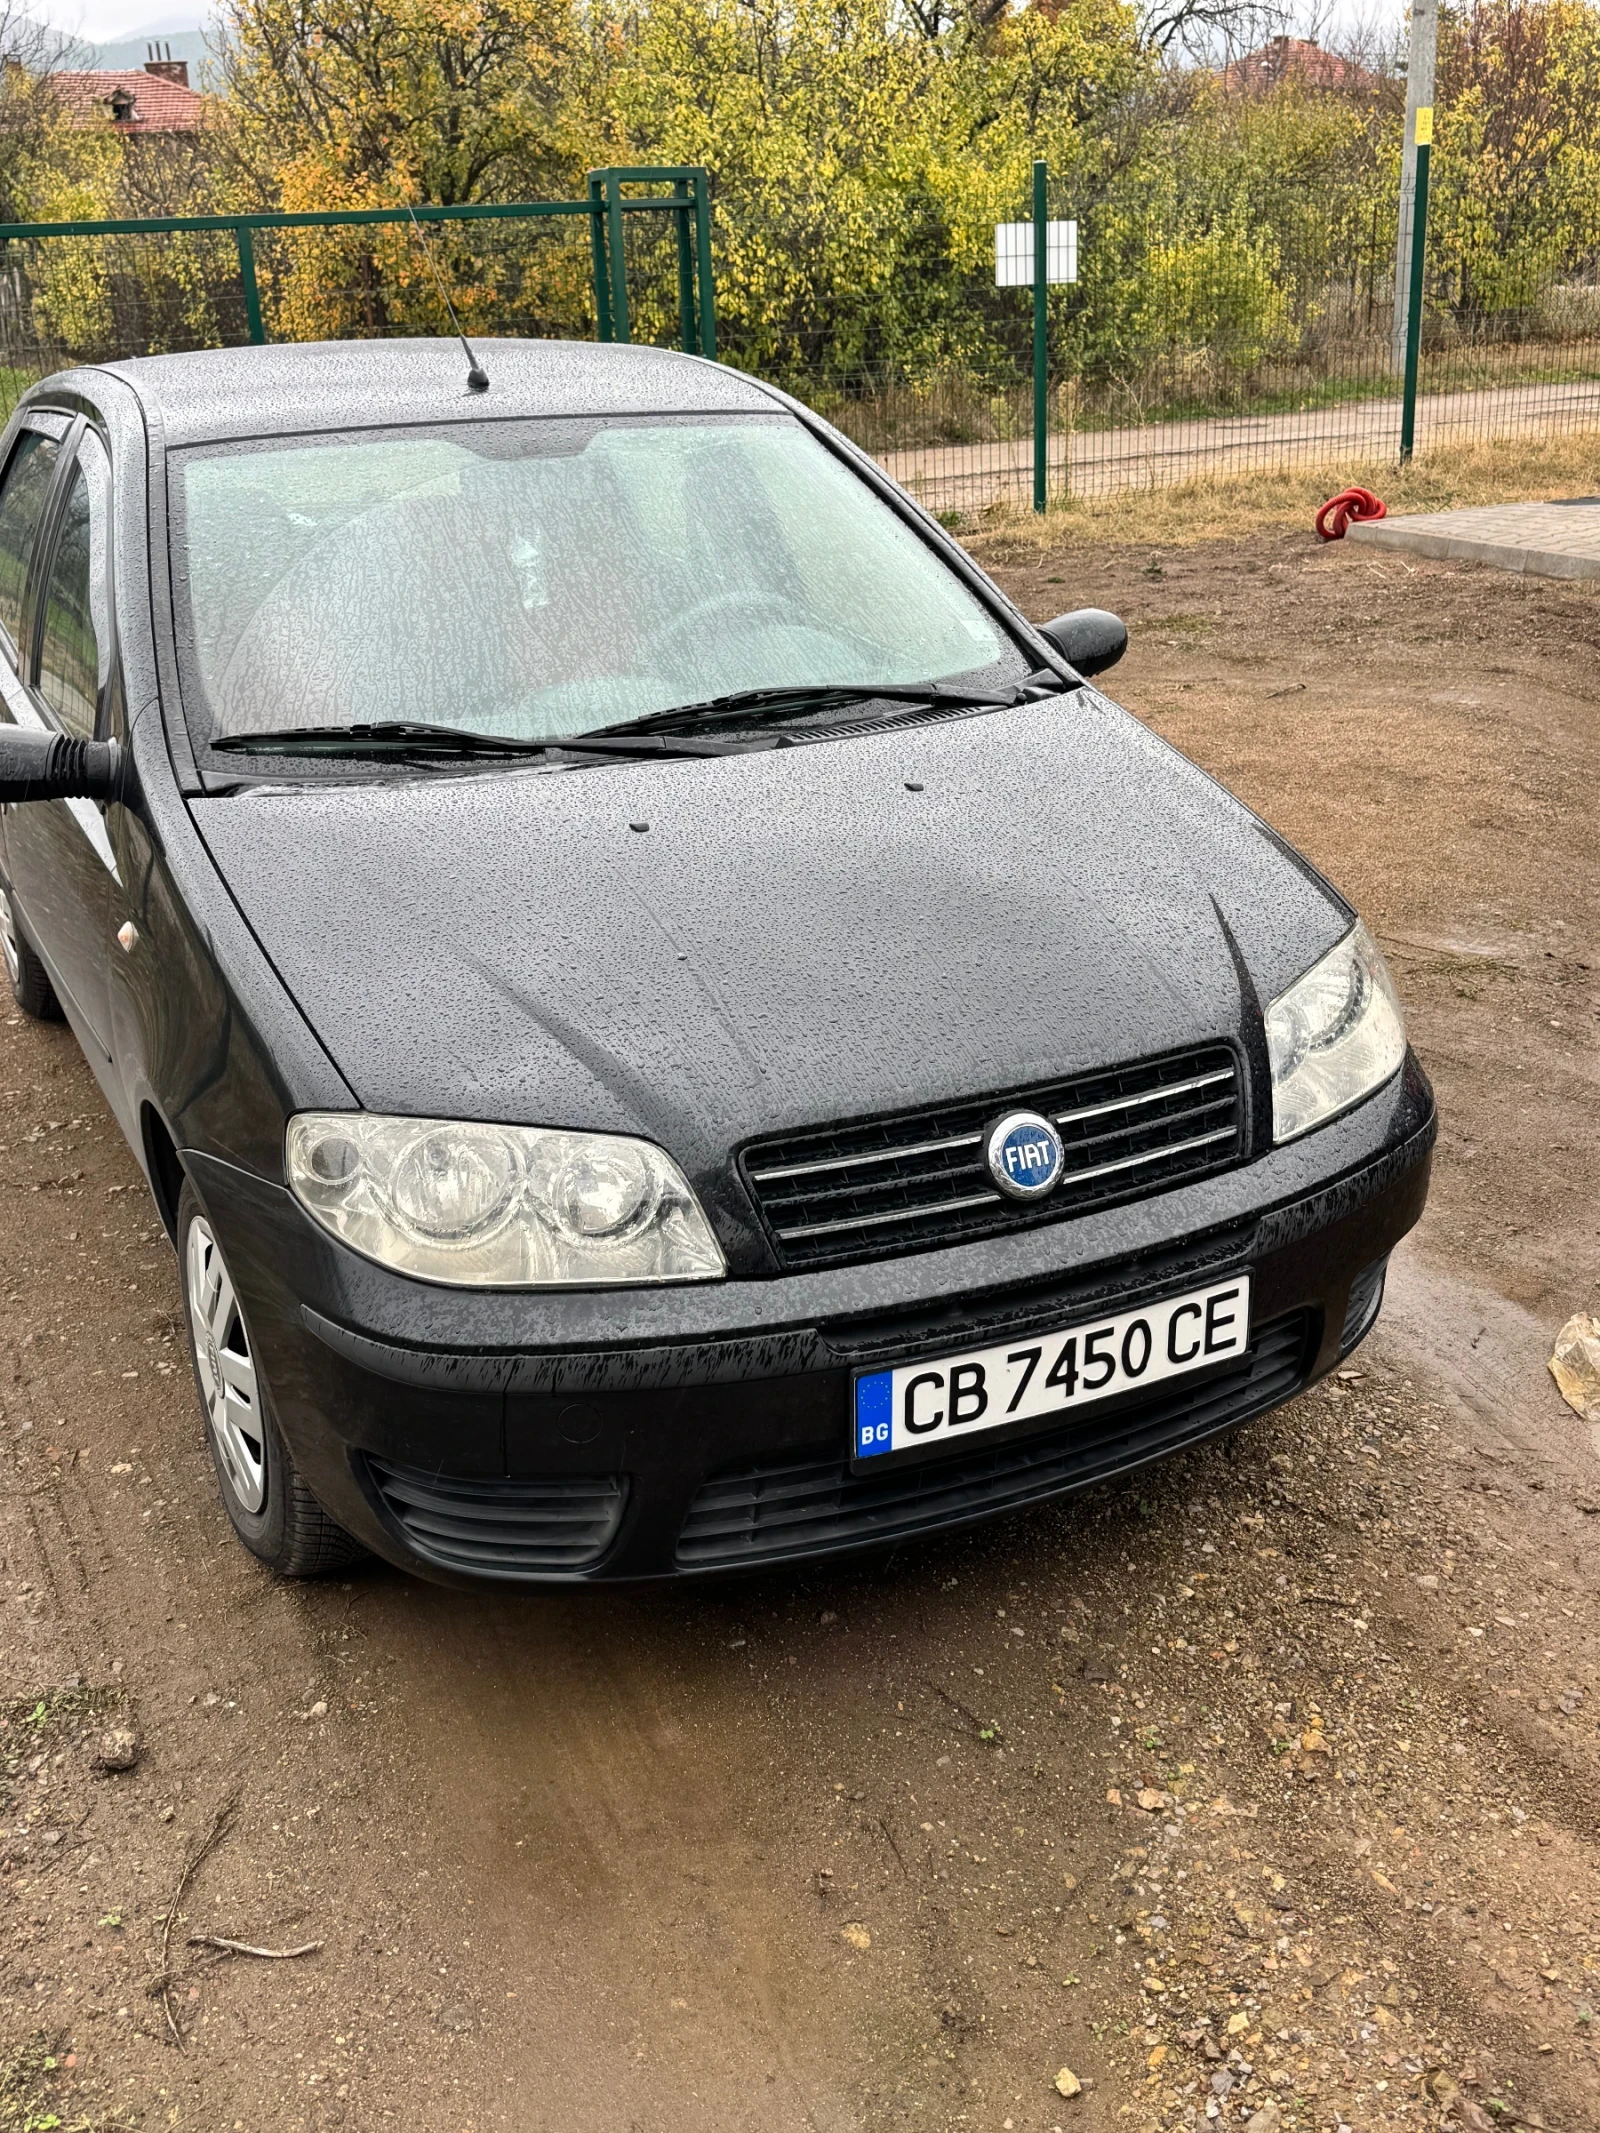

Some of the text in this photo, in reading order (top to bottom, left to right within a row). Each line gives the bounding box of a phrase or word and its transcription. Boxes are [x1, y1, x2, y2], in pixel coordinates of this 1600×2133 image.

[1005, 1140, 1050, 1173] FIAT
[904, 1288, 1240, 1434] CB 7450 CE
[861, 1422, 889, 1446] BG
